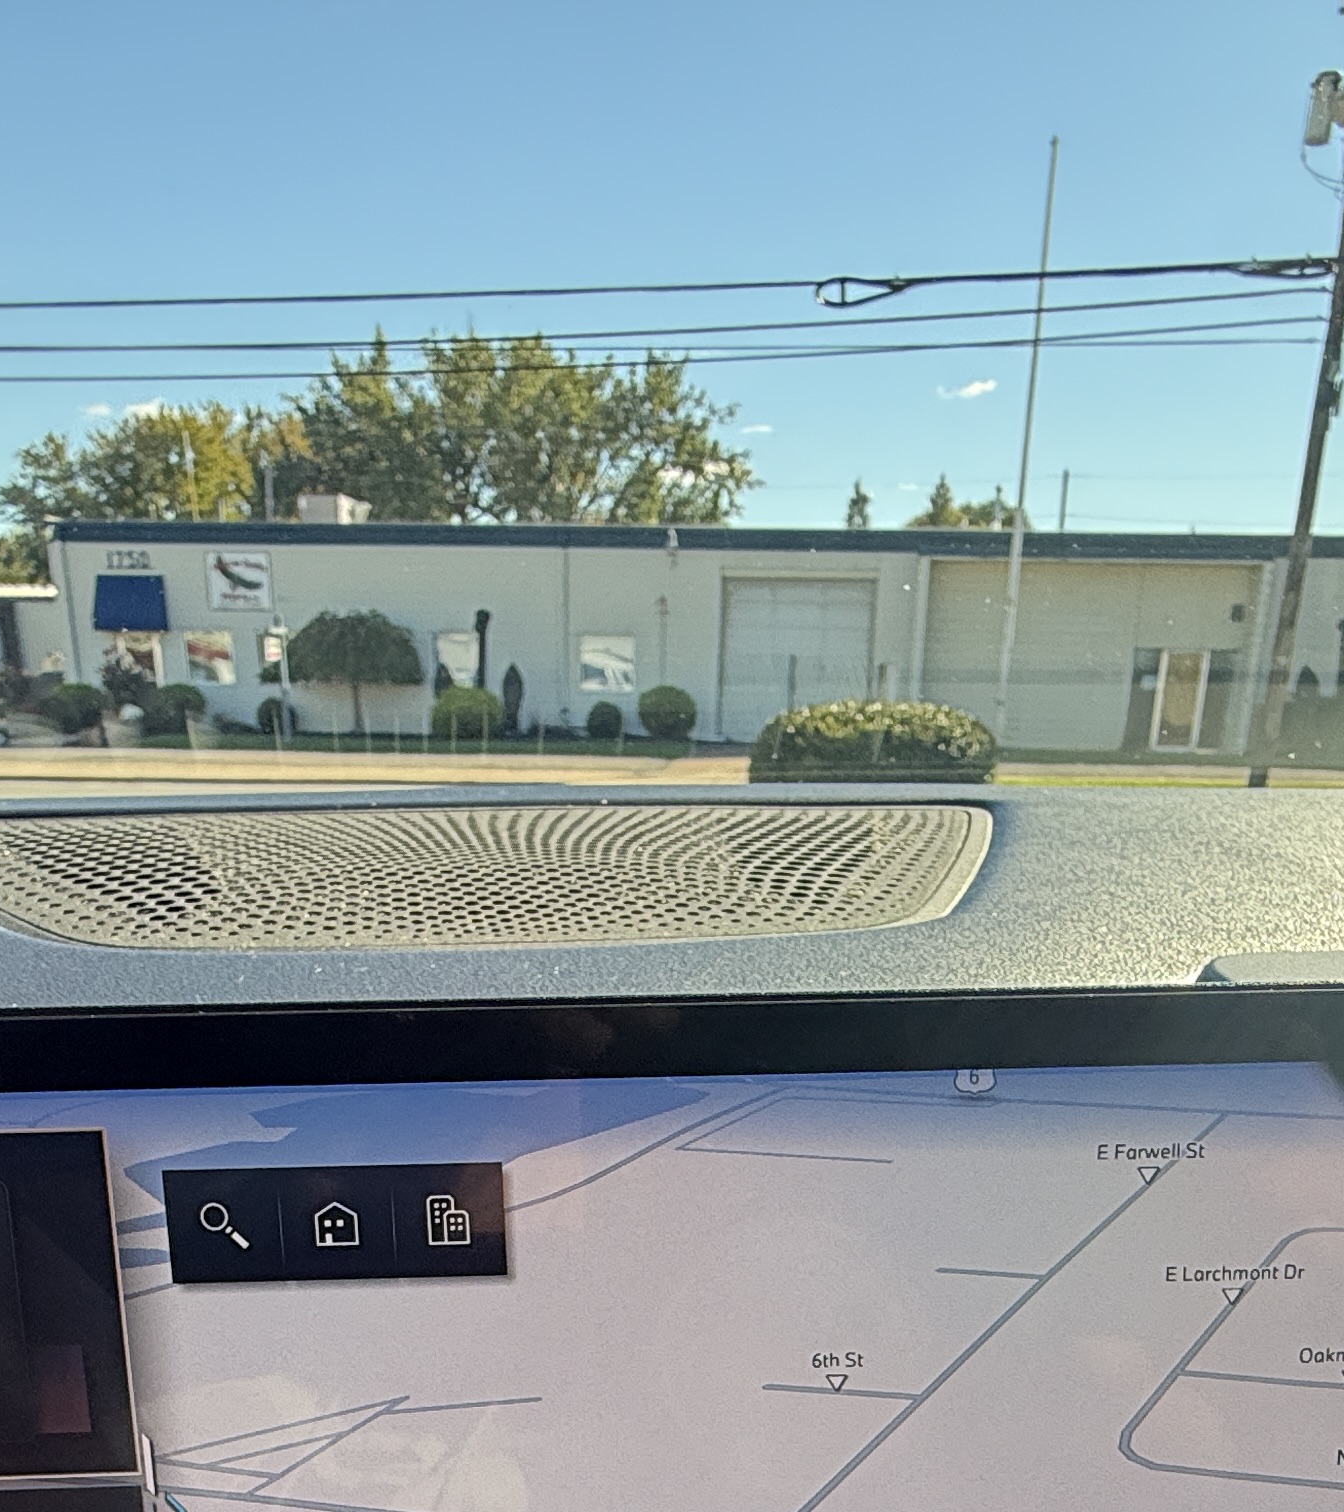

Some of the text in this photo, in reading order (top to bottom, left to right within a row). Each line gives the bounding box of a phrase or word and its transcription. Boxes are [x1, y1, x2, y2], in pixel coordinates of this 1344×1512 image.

[1096, 1142, 1206, 1162] E Farwell St
[1165, 1264, 1306, 1283] E Larchmont Dr
[811, 1351, 865, 1370] 6th St
